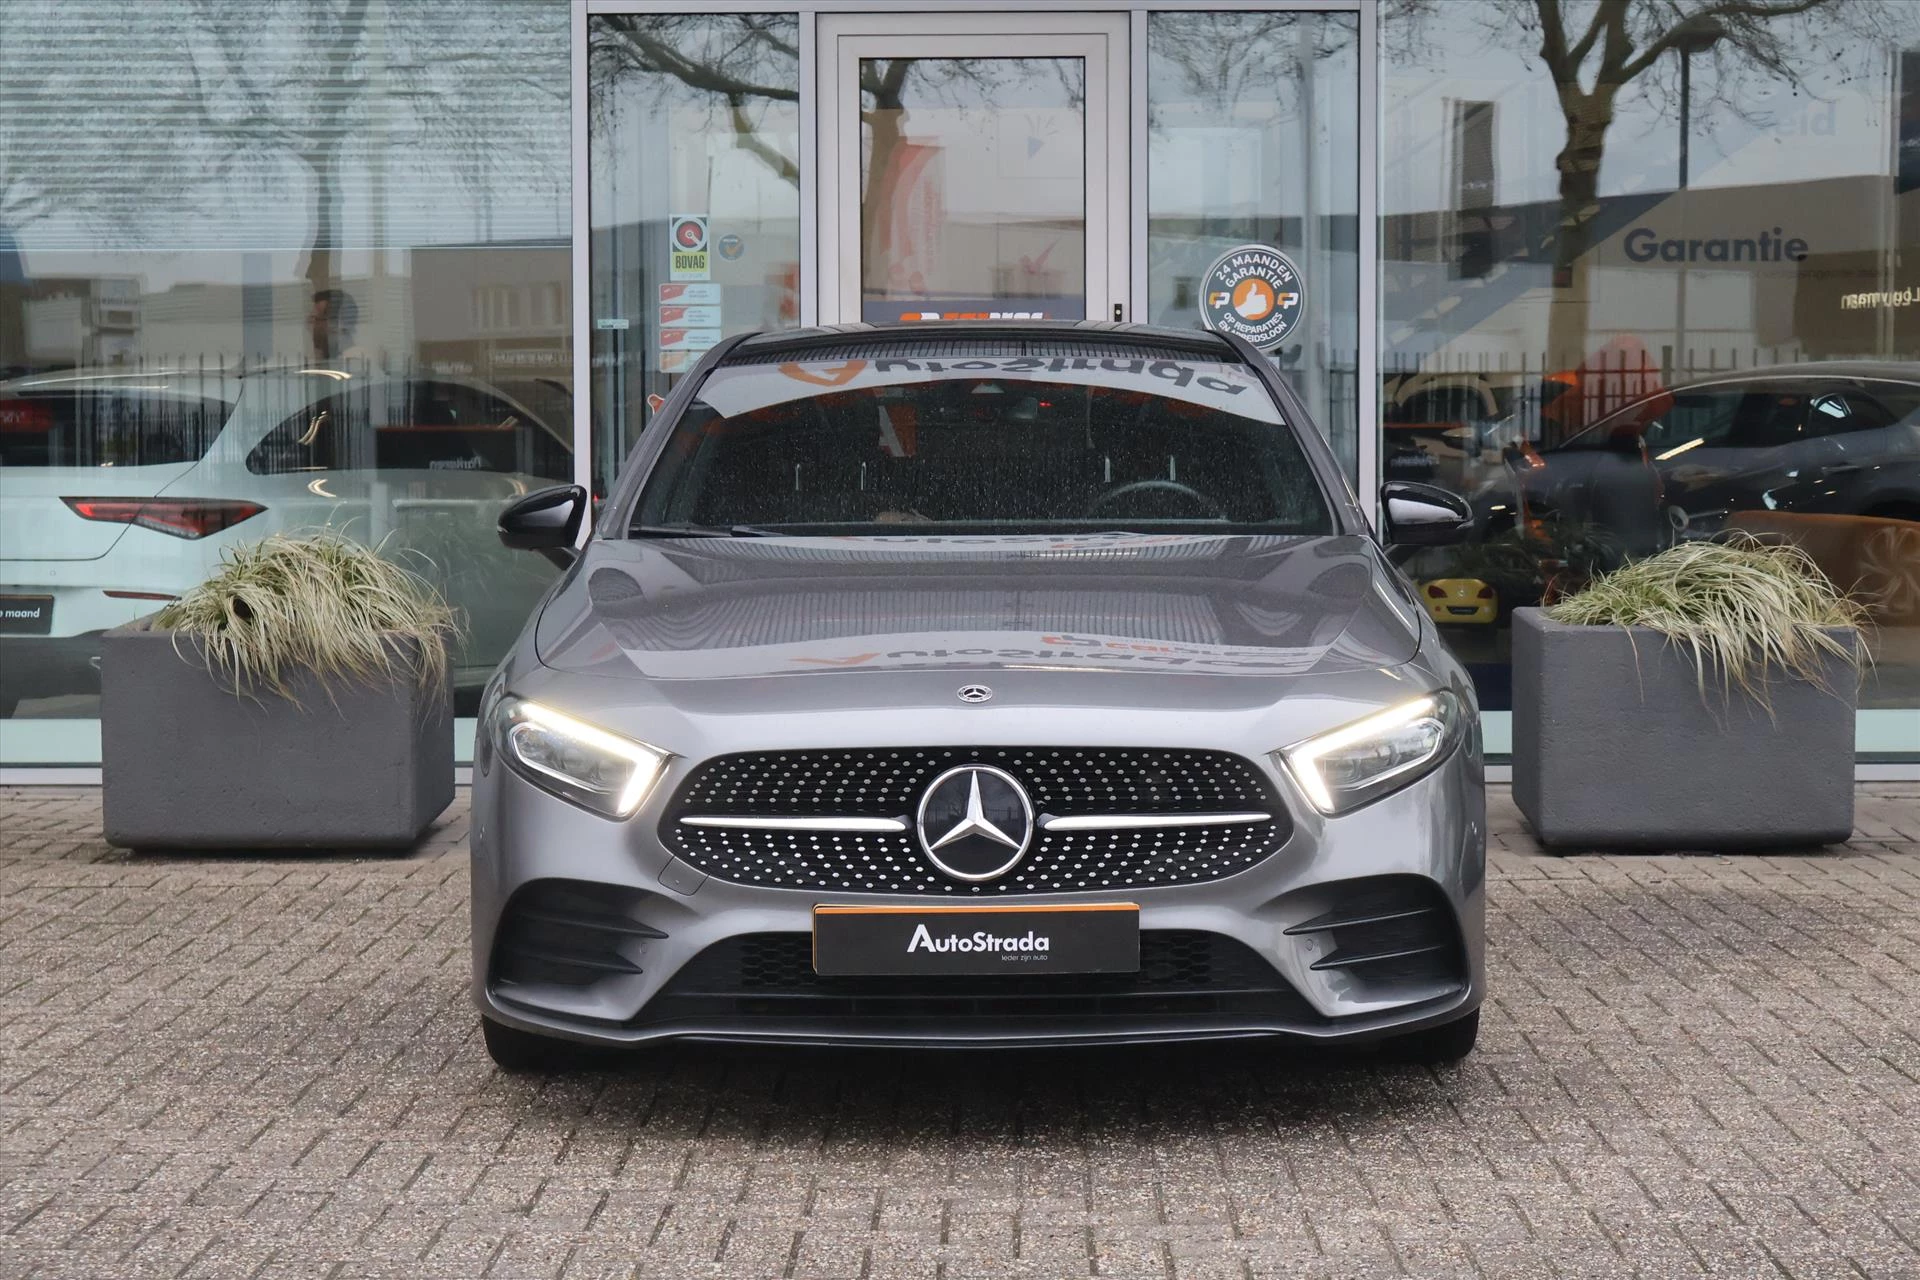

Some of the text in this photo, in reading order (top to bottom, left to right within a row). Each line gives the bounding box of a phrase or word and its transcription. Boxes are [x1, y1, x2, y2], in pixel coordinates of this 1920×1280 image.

[1623, 227, 1809, 263] Garantie
[675, 255, 705, 269] BOVAG
[1216, 254, 1293, 283] 24 MAANDEN
[1225, 266, 1283, 289] GARANTIE
[1218, 320, 1231, 332] EN
[1223, 312, 1283, 334] OP REPARATIES
[5, 608, 40, 618] maand
[907, 923, 1050, 953] AutoStrada
[1020, 954, 1032, 963] zijn
